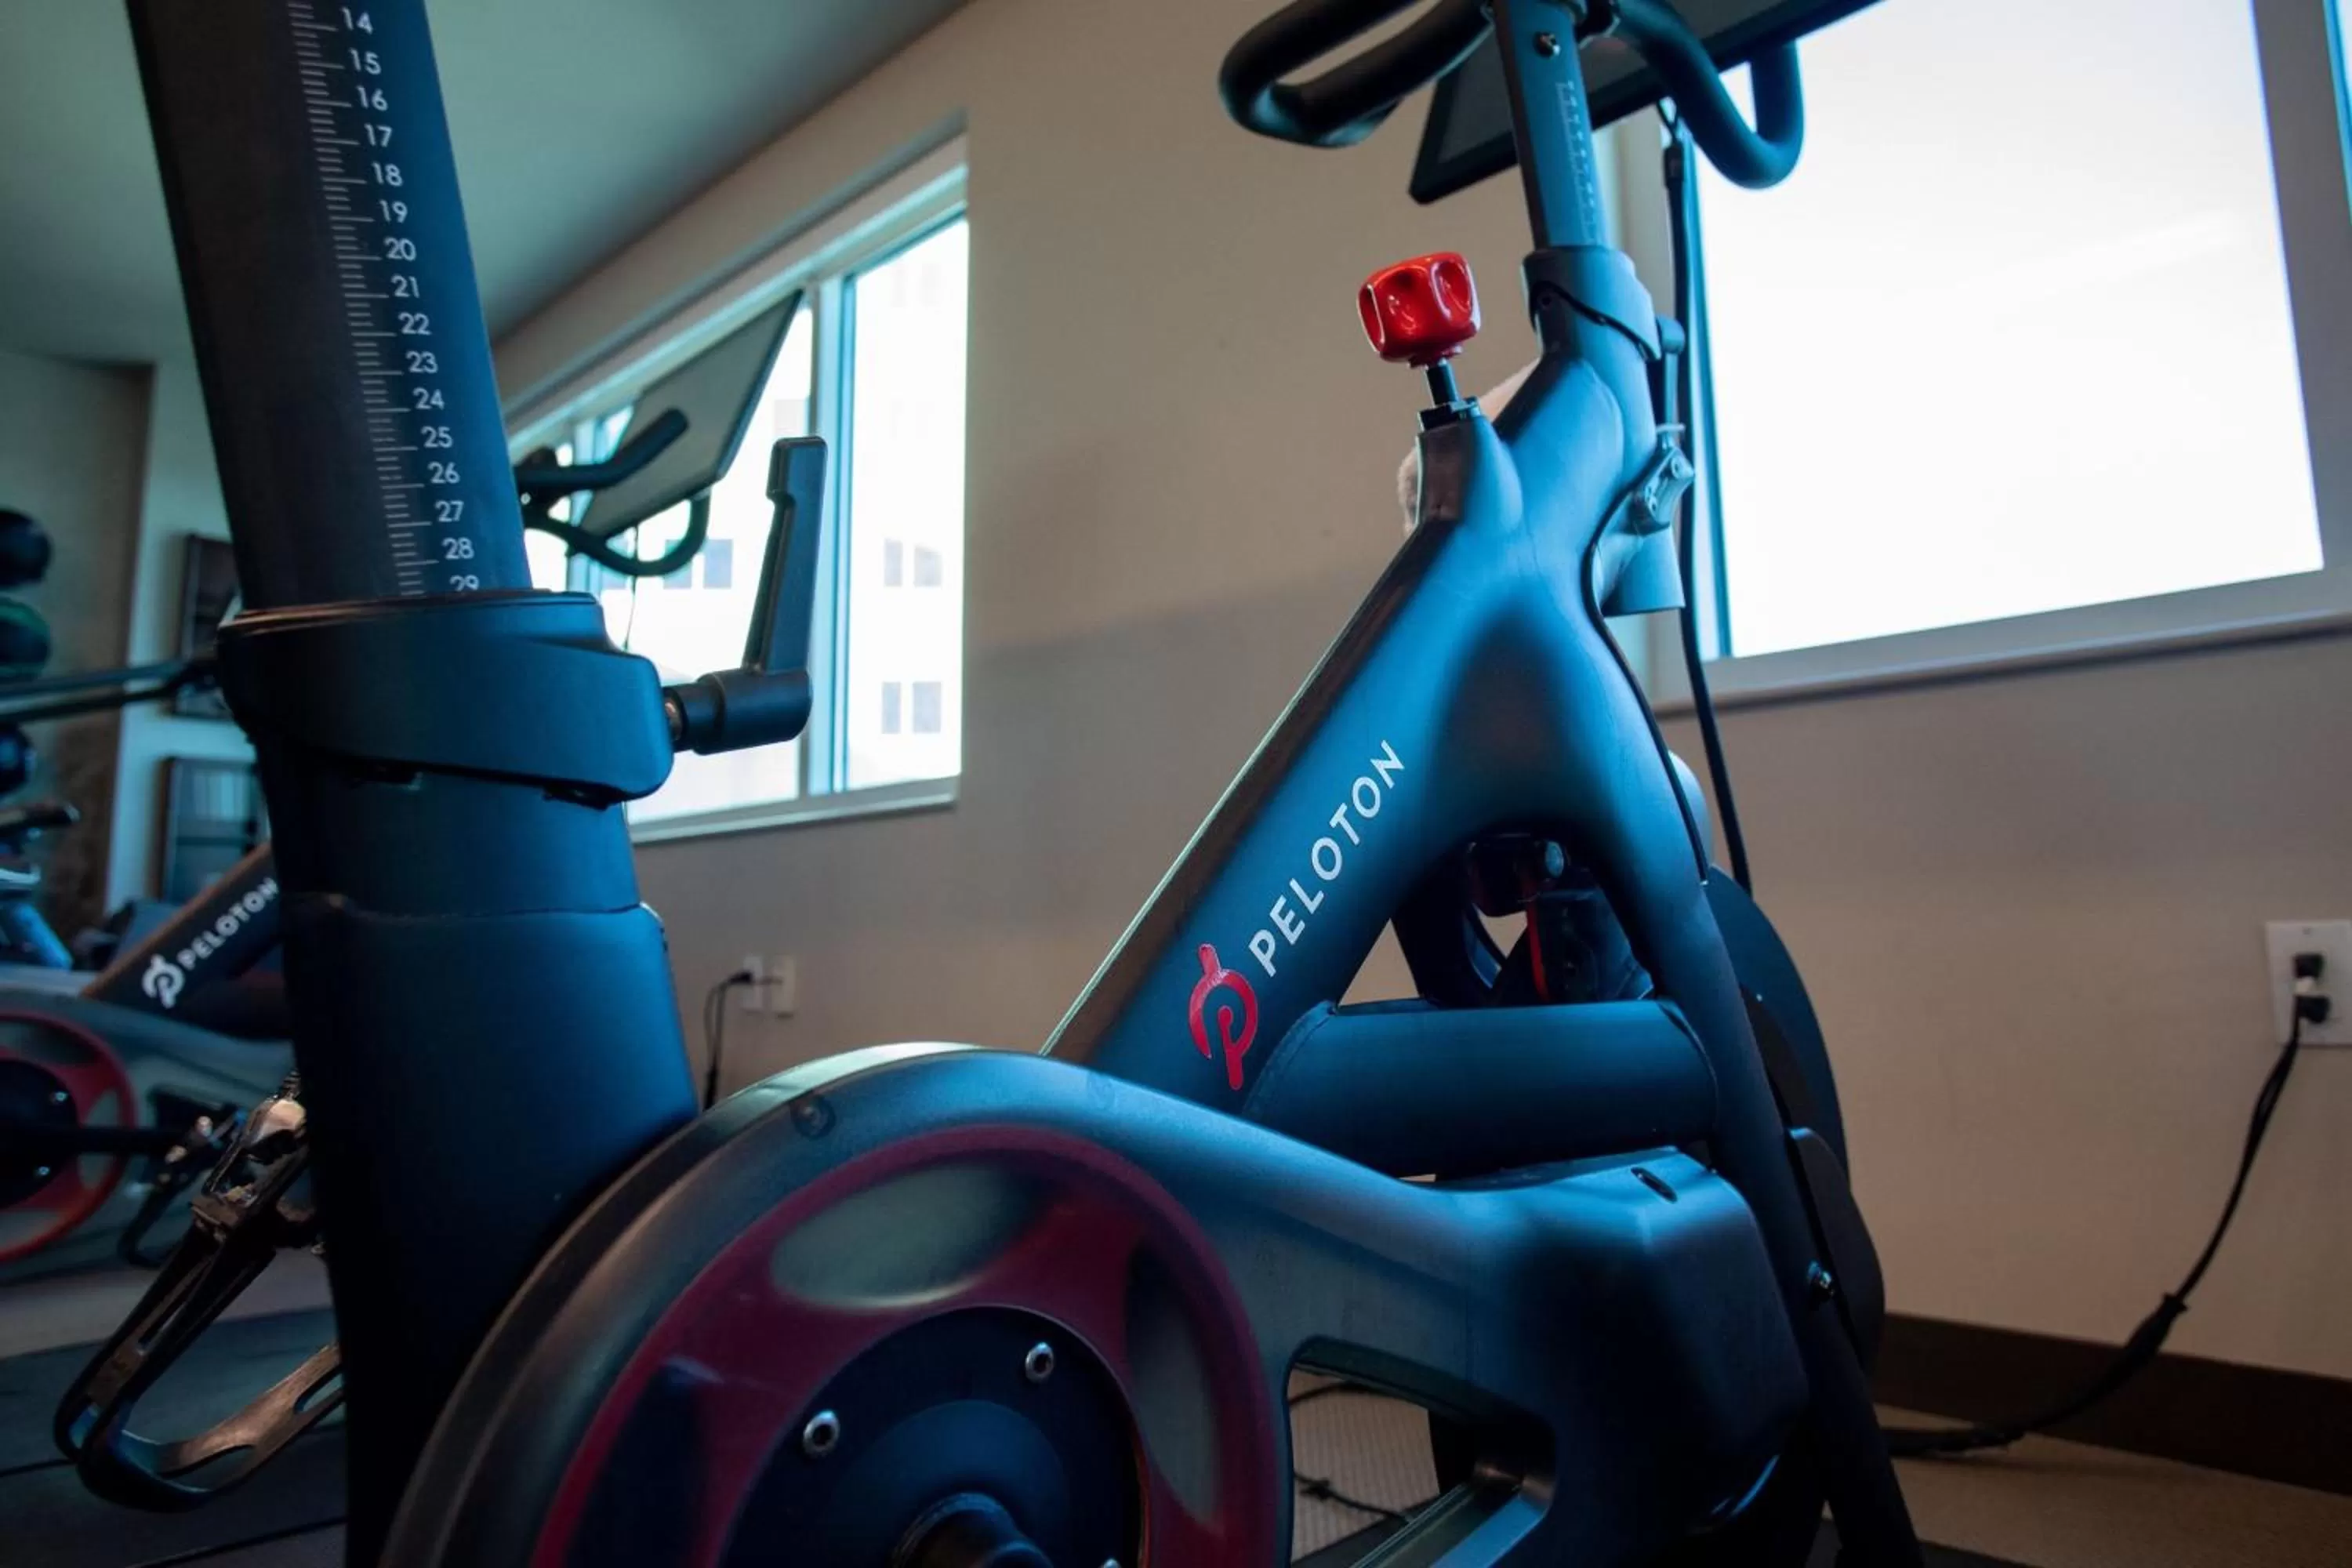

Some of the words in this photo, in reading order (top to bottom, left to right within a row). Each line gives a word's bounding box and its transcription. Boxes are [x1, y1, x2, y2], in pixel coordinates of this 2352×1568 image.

[340, 6, 374, 34] 14
[349, 47, 383, 75] 15
[356, 85, 390, 112] 16
[364, 122, 394, 148] 17
[371, 160, 404, 187] 18
[379, 198, 409, 224] 19
[383, 237, 418, 262] 20
[390, 274, 421, 299] 21
[397, 312, 431, 336] 22
[405, 350, 439, 374] 23
[412, 387, 445, 411] 24
[420, 426, 454, 449] 25
[427, 462, 461, 485] 26
[434, 500, 465, 523] 27
[441, 537, 475, 561] 28
[448, 575, 480, 593] 29
[1247, 739, 1406, 978] PELOTON
[176, 877, 278, 971] PELOTON
